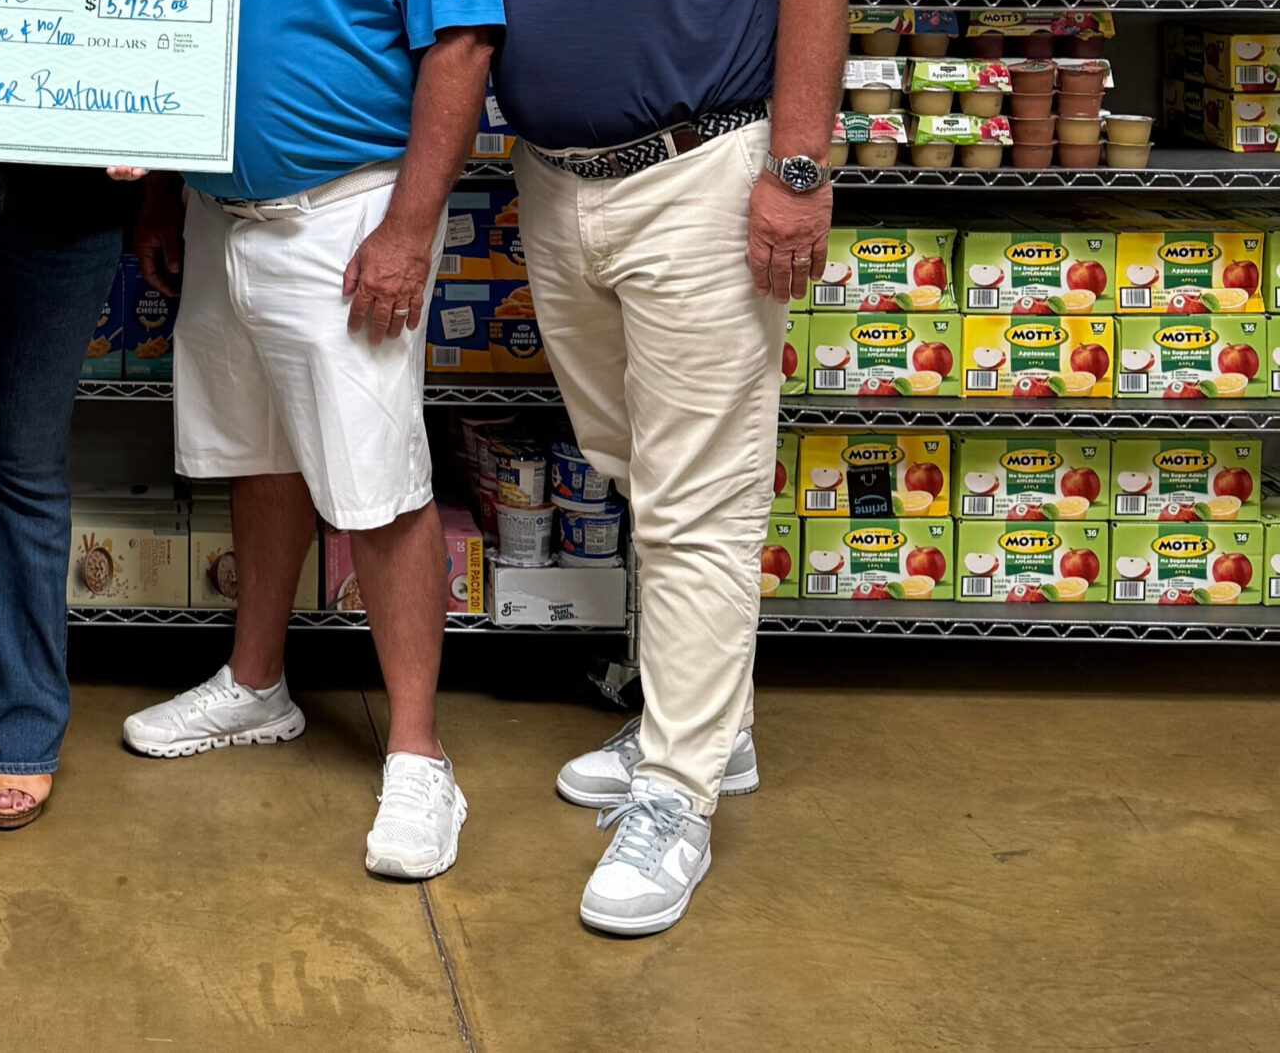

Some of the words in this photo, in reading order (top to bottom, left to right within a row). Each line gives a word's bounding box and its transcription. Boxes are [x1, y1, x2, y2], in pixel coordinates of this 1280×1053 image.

[88, 37, 147, 49] DOLLARS
[31, 69, 180, 114] Restaurants
[858, 245, 906, 255] MOTT'S
[1012, 248, 1061, 259] MOTT'S
[1165, 248, 1214, 258] MOTT'S
[858, 330, 907, 340] MOTT'S
[1012, 330, 1061, 340] MOTT'S
[1160, 332, 1211, 342] MOTT'S
[848, 450, 898, 460] MOTT'S
[1006, 455, 1056, 466] MOTT'S
[1160, 455, 1209, 466] MOTT'S
[854, 504, 888, 516] prime
[850, 534, 900, 545] MOTT'S
[1005, 536, 1055, 547] MOTT'S
[1158, 541, 1208, 551] MOTT'S
[470, 540, 481, 569] VALUE
[470, 570, 481, 595] PACK
